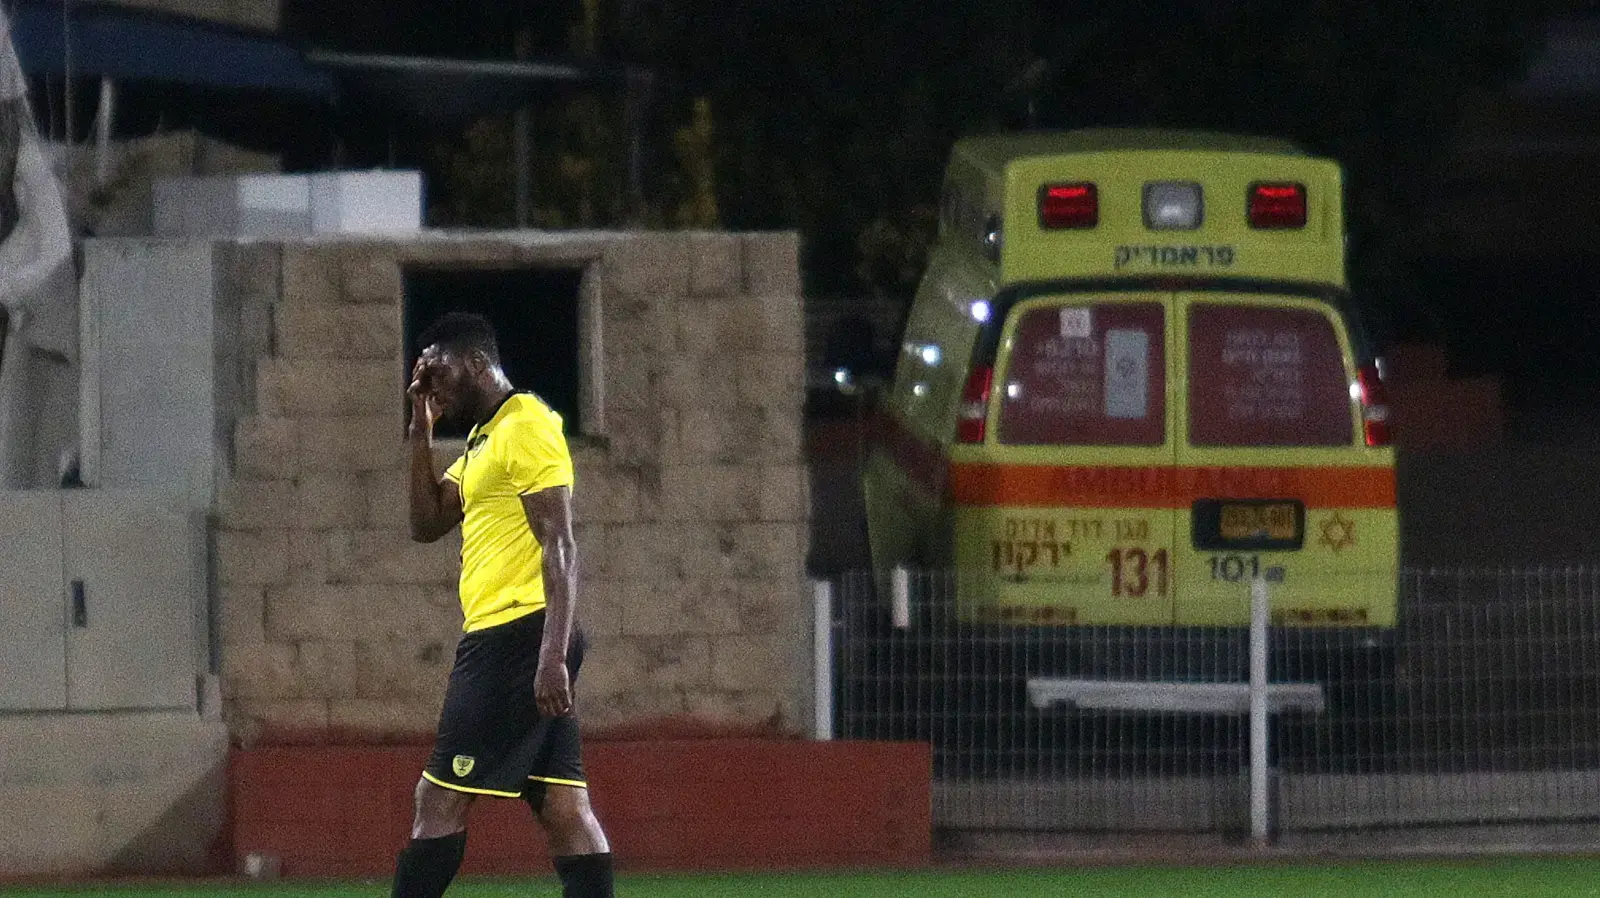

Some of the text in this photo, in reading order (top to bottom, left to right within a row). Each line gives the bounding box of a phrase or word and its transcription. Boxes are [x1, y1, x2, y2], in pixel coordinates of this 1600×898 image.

[1114, 245, 1234, 268] פראמדיק
[1006, 517, 1148, 540] מגן דוד אדום
[991, 540, 1071, 571] ירקון
[1207, 554, 1258, 581] 101
[1105, 547, 1168, 597] 131
